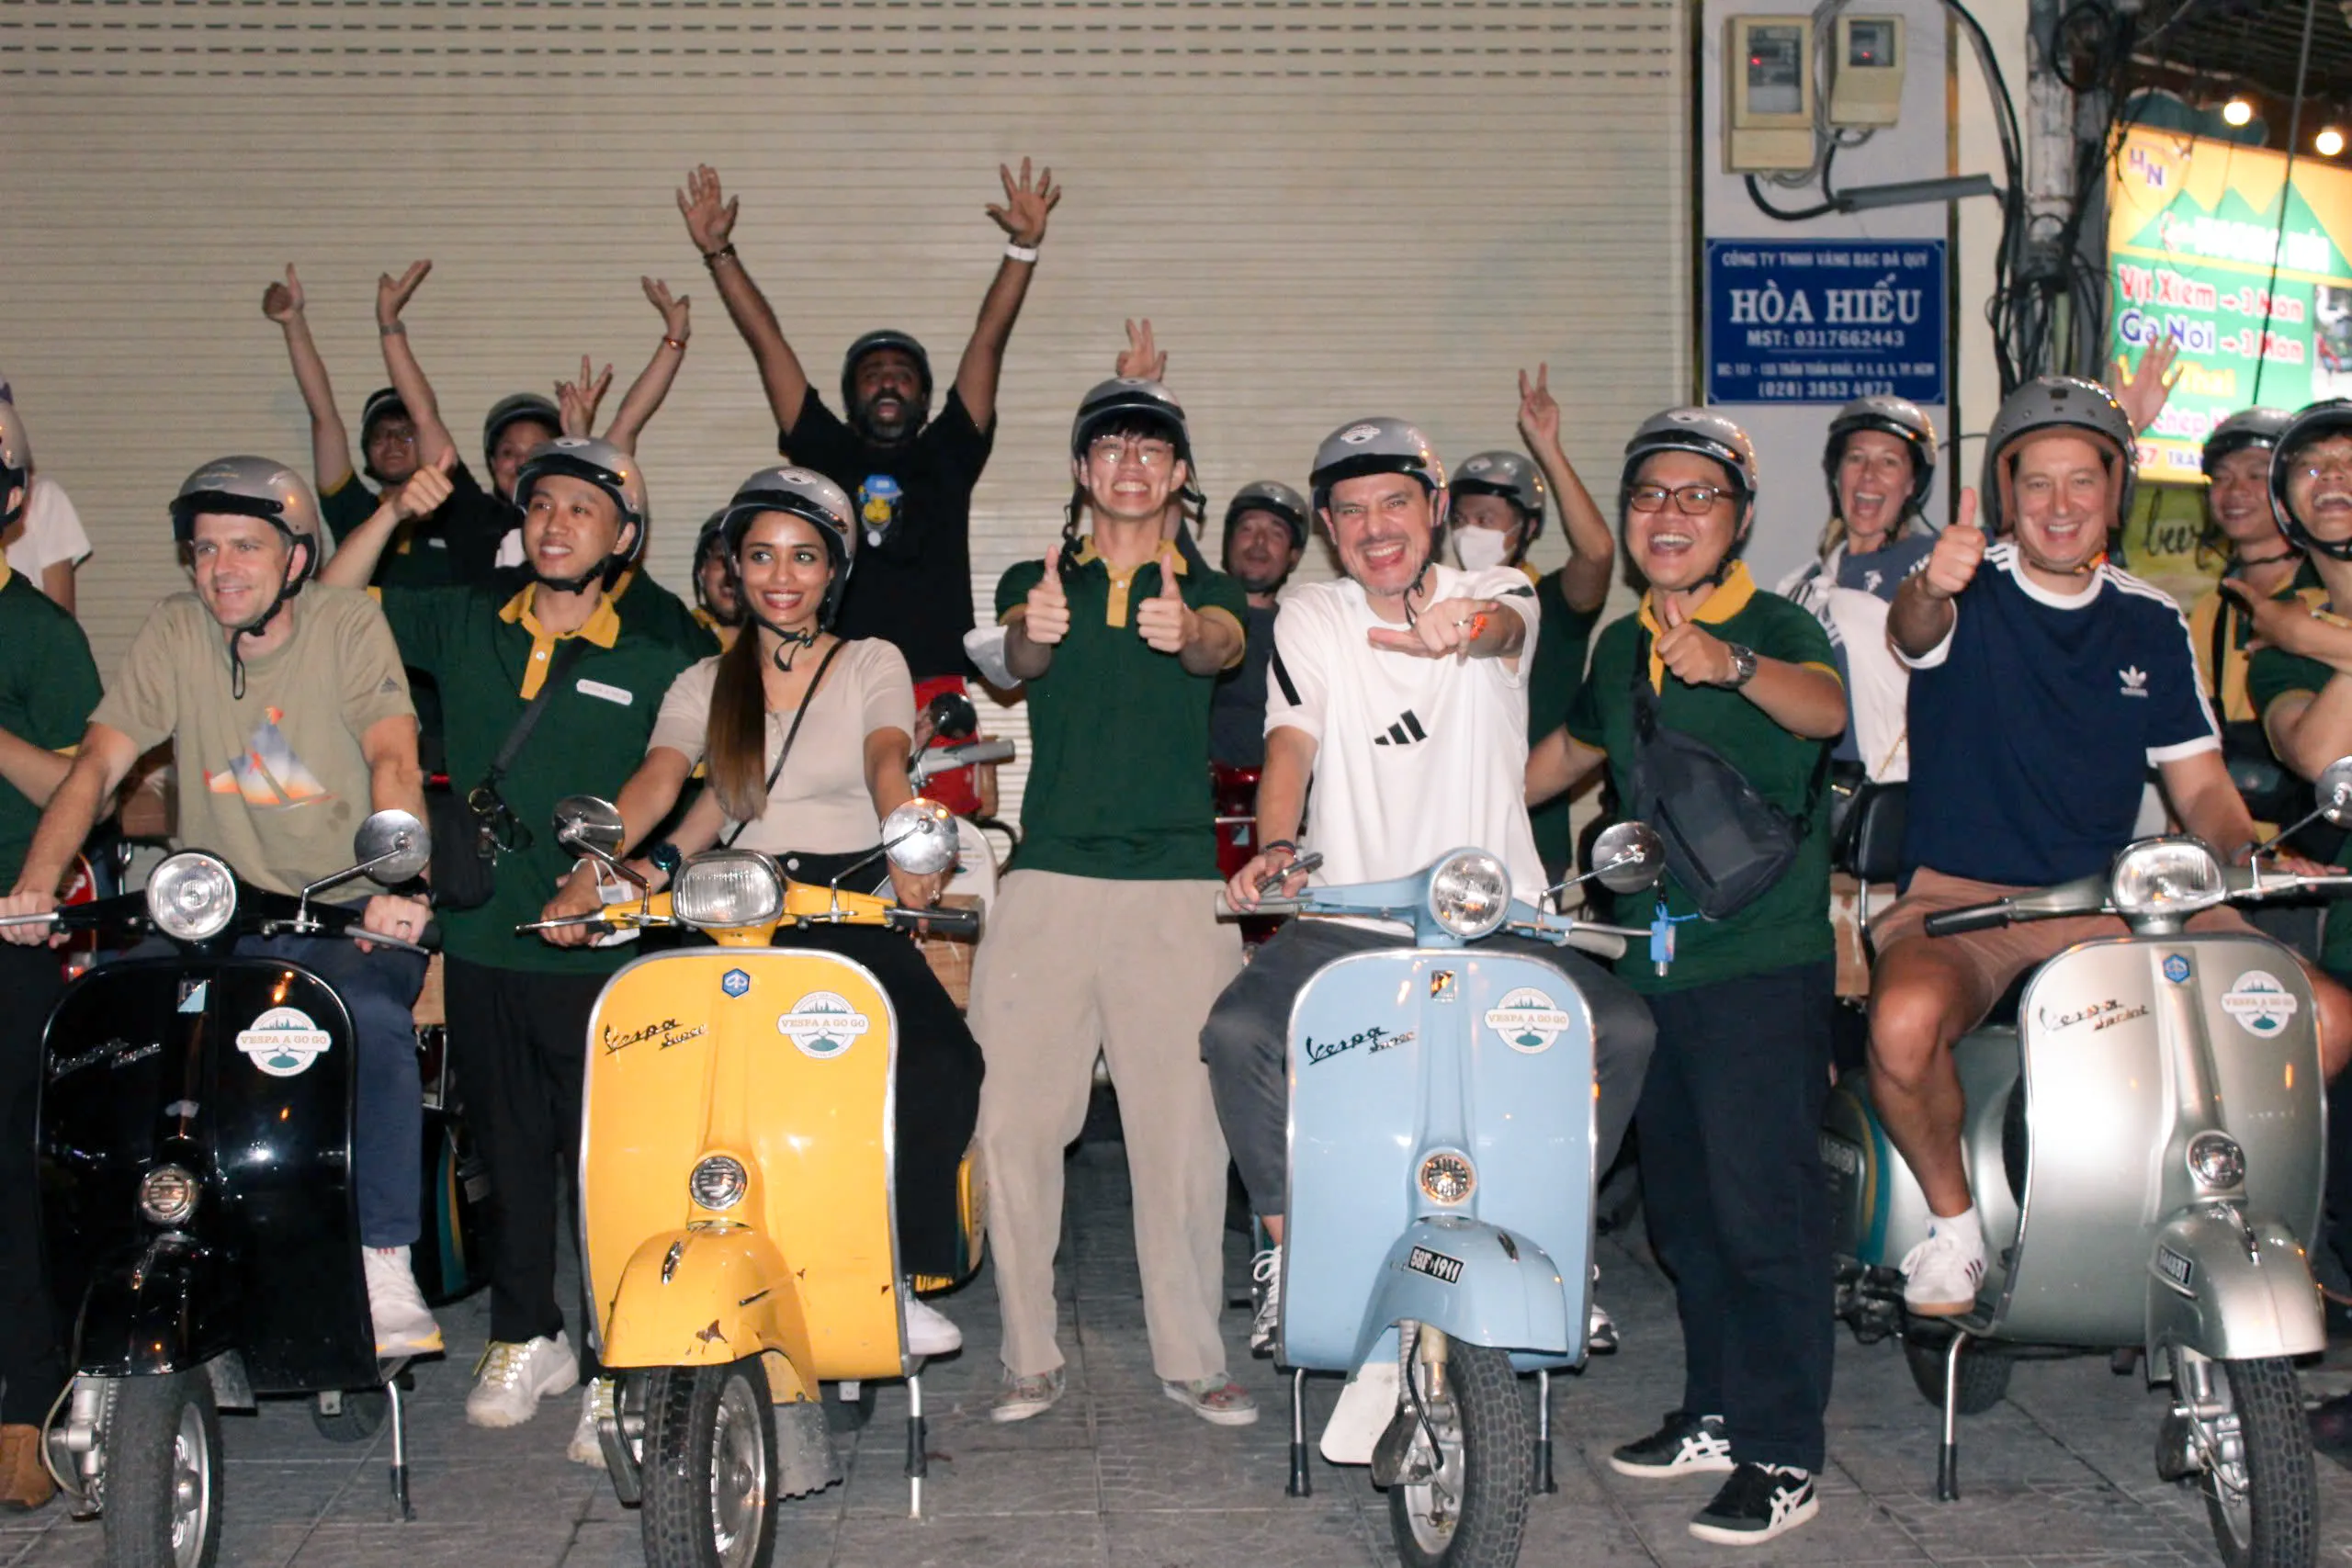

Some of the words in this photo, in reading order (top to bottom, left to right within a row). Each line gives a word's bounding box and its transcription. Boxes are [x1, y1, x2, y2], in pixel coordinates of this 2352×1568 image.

[1729, 278, 1815, 323] HÒA
[1747, 330, 1789, 346] MST:
[781, 1019, 820, 1028] VESPA
[822, 1019, 831, 1027] A
[833, 1019, 848, 1028] GO
[851, 1019, 865, 1028] GO
[1488, 1013, 1524, 1022] VESPA
[241, 1036, 279, 1044] VESPA
[282, 1036, 291, 1044] A
[294, 1036, 309, 1044] GO
[311, 1036, 327, 1044] GO
[604, 1019, 684, 1055] Vespa
[1306, 1026, 1390, 1066] Vespa
